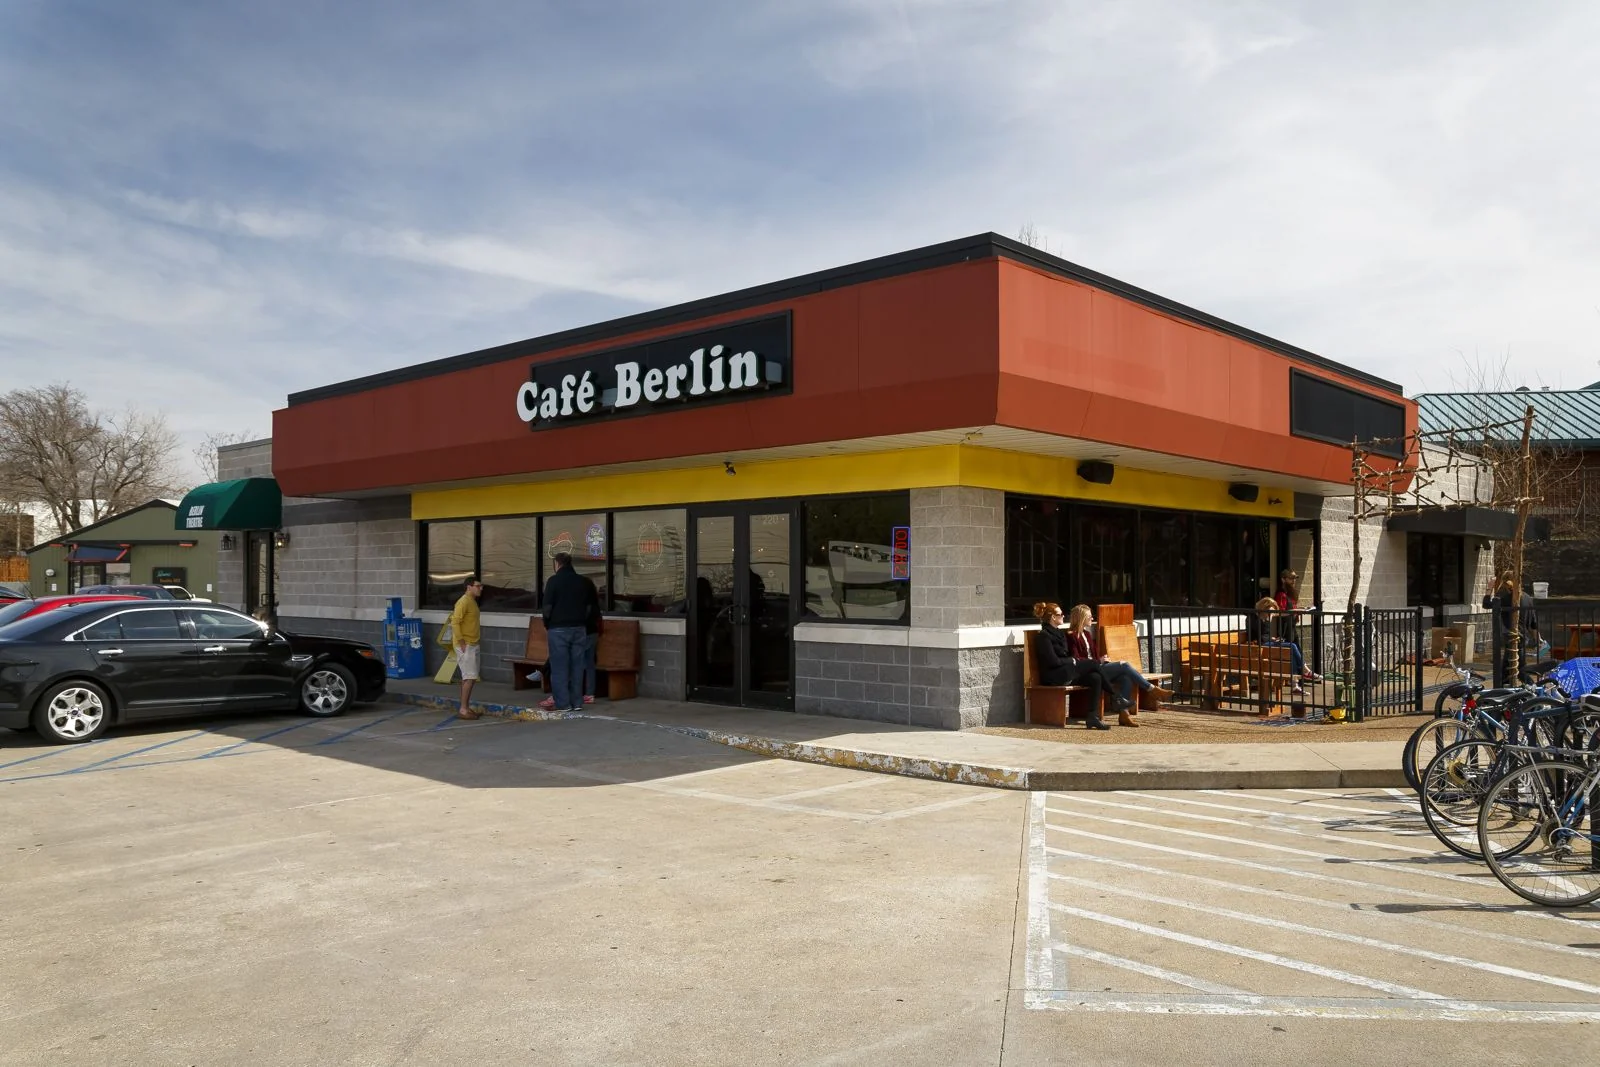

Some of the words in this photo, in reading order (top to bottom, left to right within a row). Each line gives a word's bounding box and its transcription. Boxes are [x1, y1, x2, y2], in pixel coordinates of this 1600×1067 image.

[516, 370, 595, 422] Café
[615, 344, 759, 408] Berlin
[894, 529, 908, 577] OPEN
